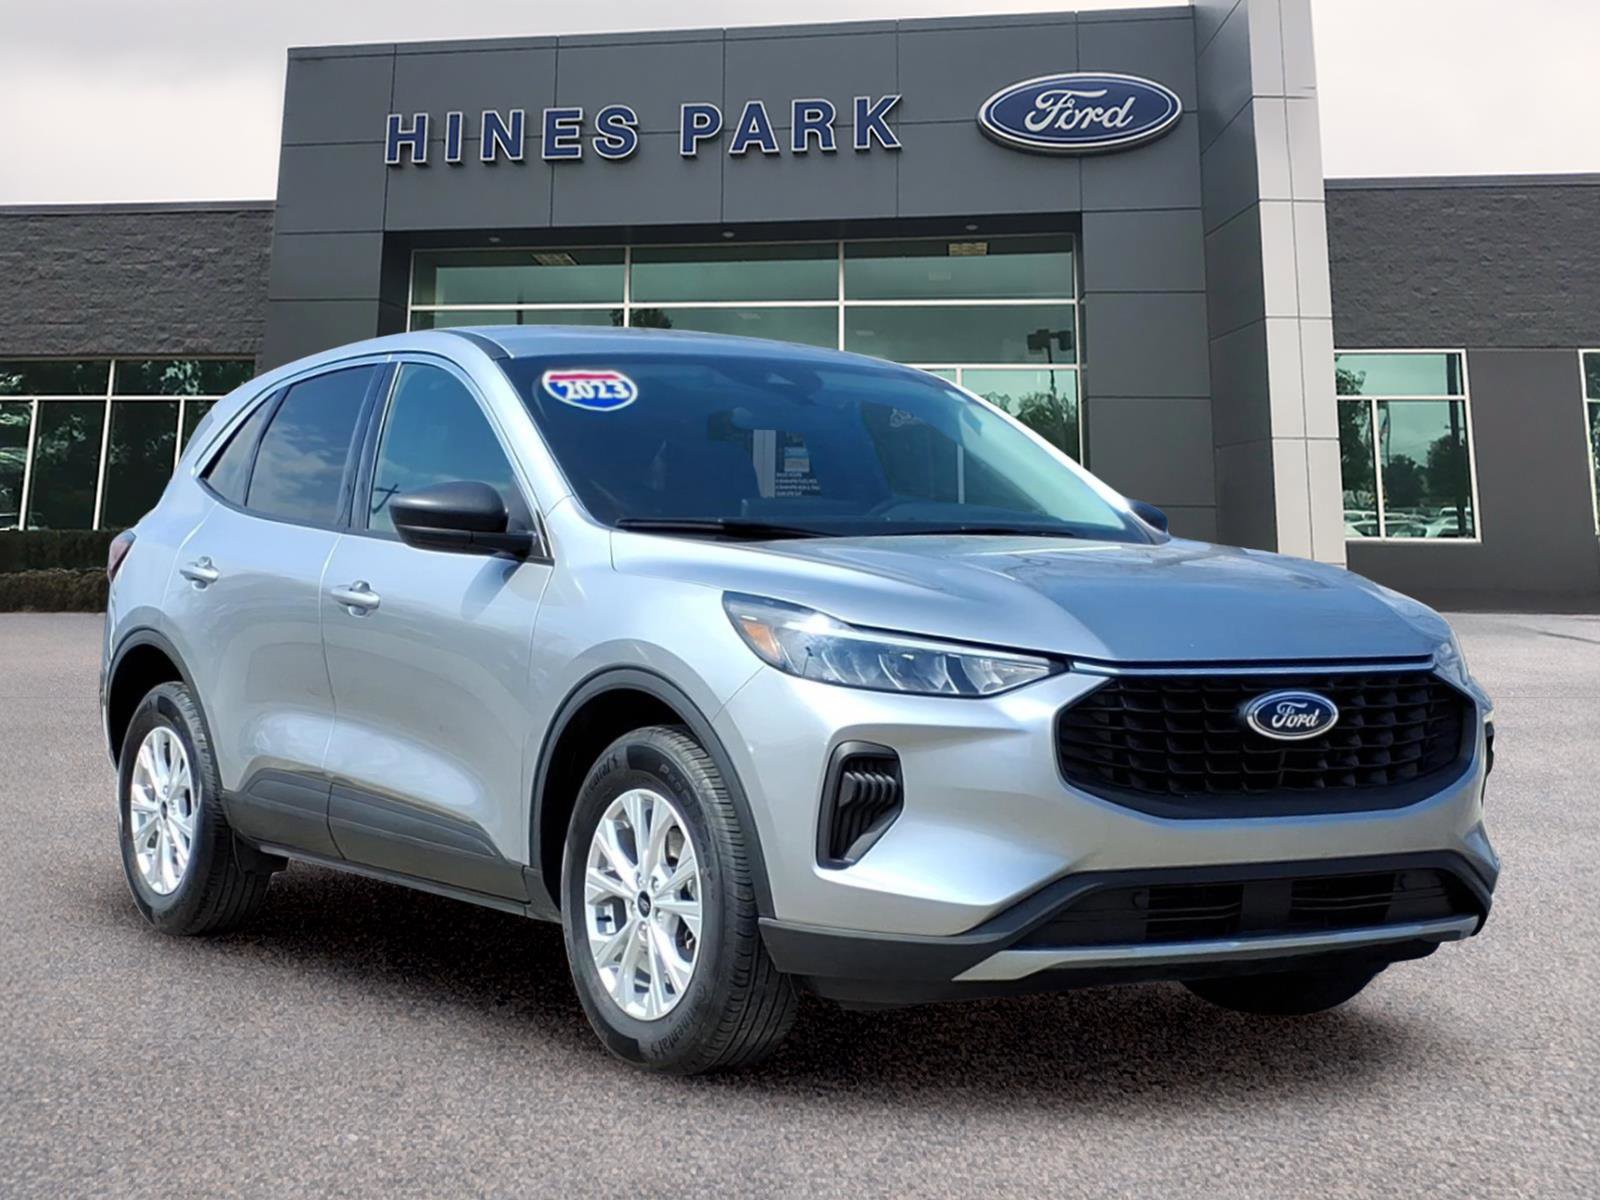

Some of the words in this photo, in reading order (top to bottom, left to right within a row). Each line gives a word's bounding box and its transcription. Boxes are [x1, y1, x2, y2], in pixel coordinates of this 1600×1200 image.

[1023, 88, 1137, 133] Ford
[384, 104, 639, 165] HINES
[679, 94, 902, 157] PARK
[557, 380, 631, 401] 2023
[1271, 701, 1320, 729] Ford
